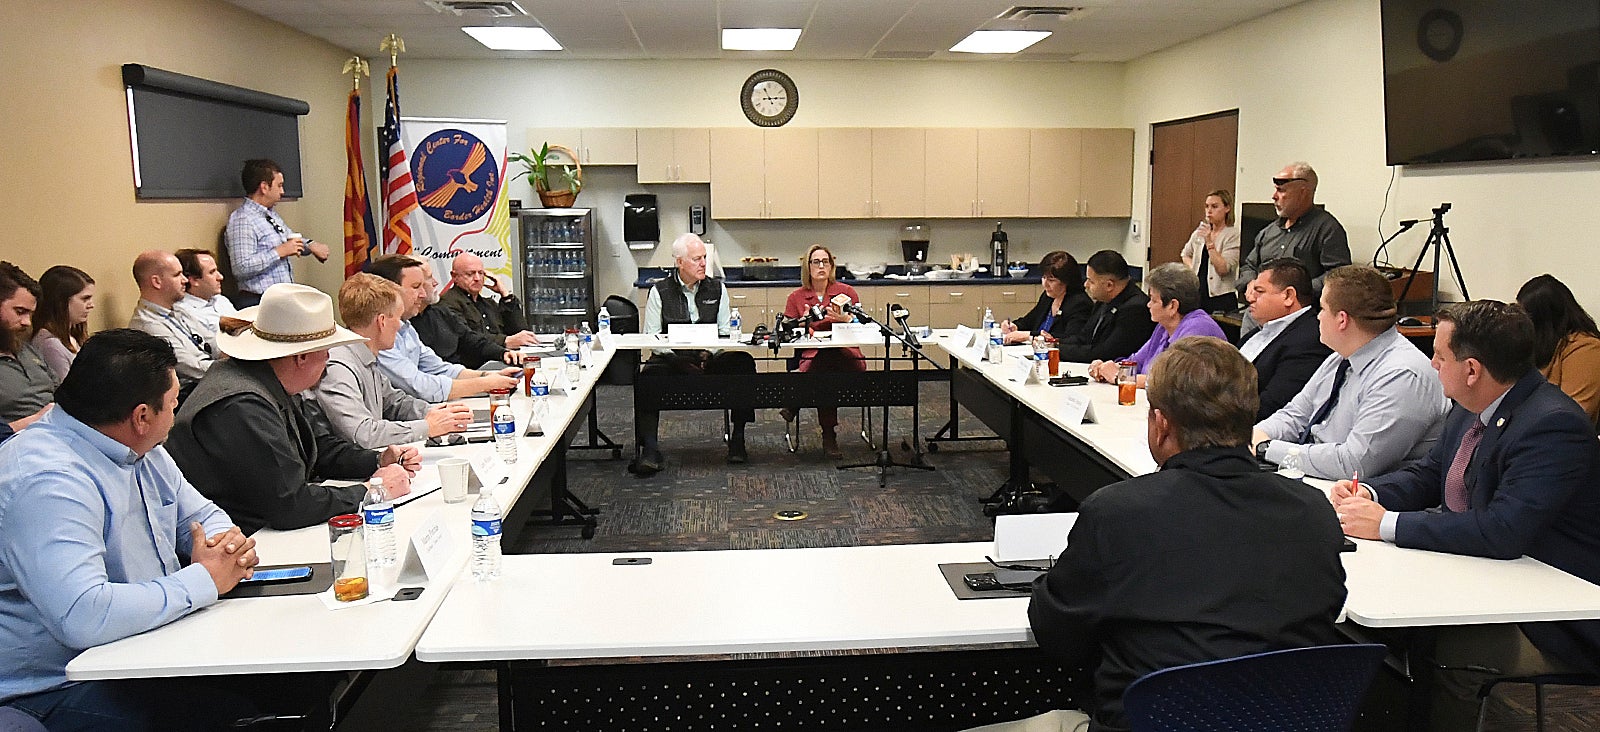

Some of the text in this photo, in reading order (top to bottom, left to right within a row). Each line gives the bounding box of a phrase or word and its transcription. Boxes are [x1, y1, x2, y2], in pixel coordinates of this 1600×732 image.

[426, 138, 451, 155] Center
[453, 134, 469, 146] For
[443, 209, 473, 221] Border
[472, 188, 493, 215] Health
